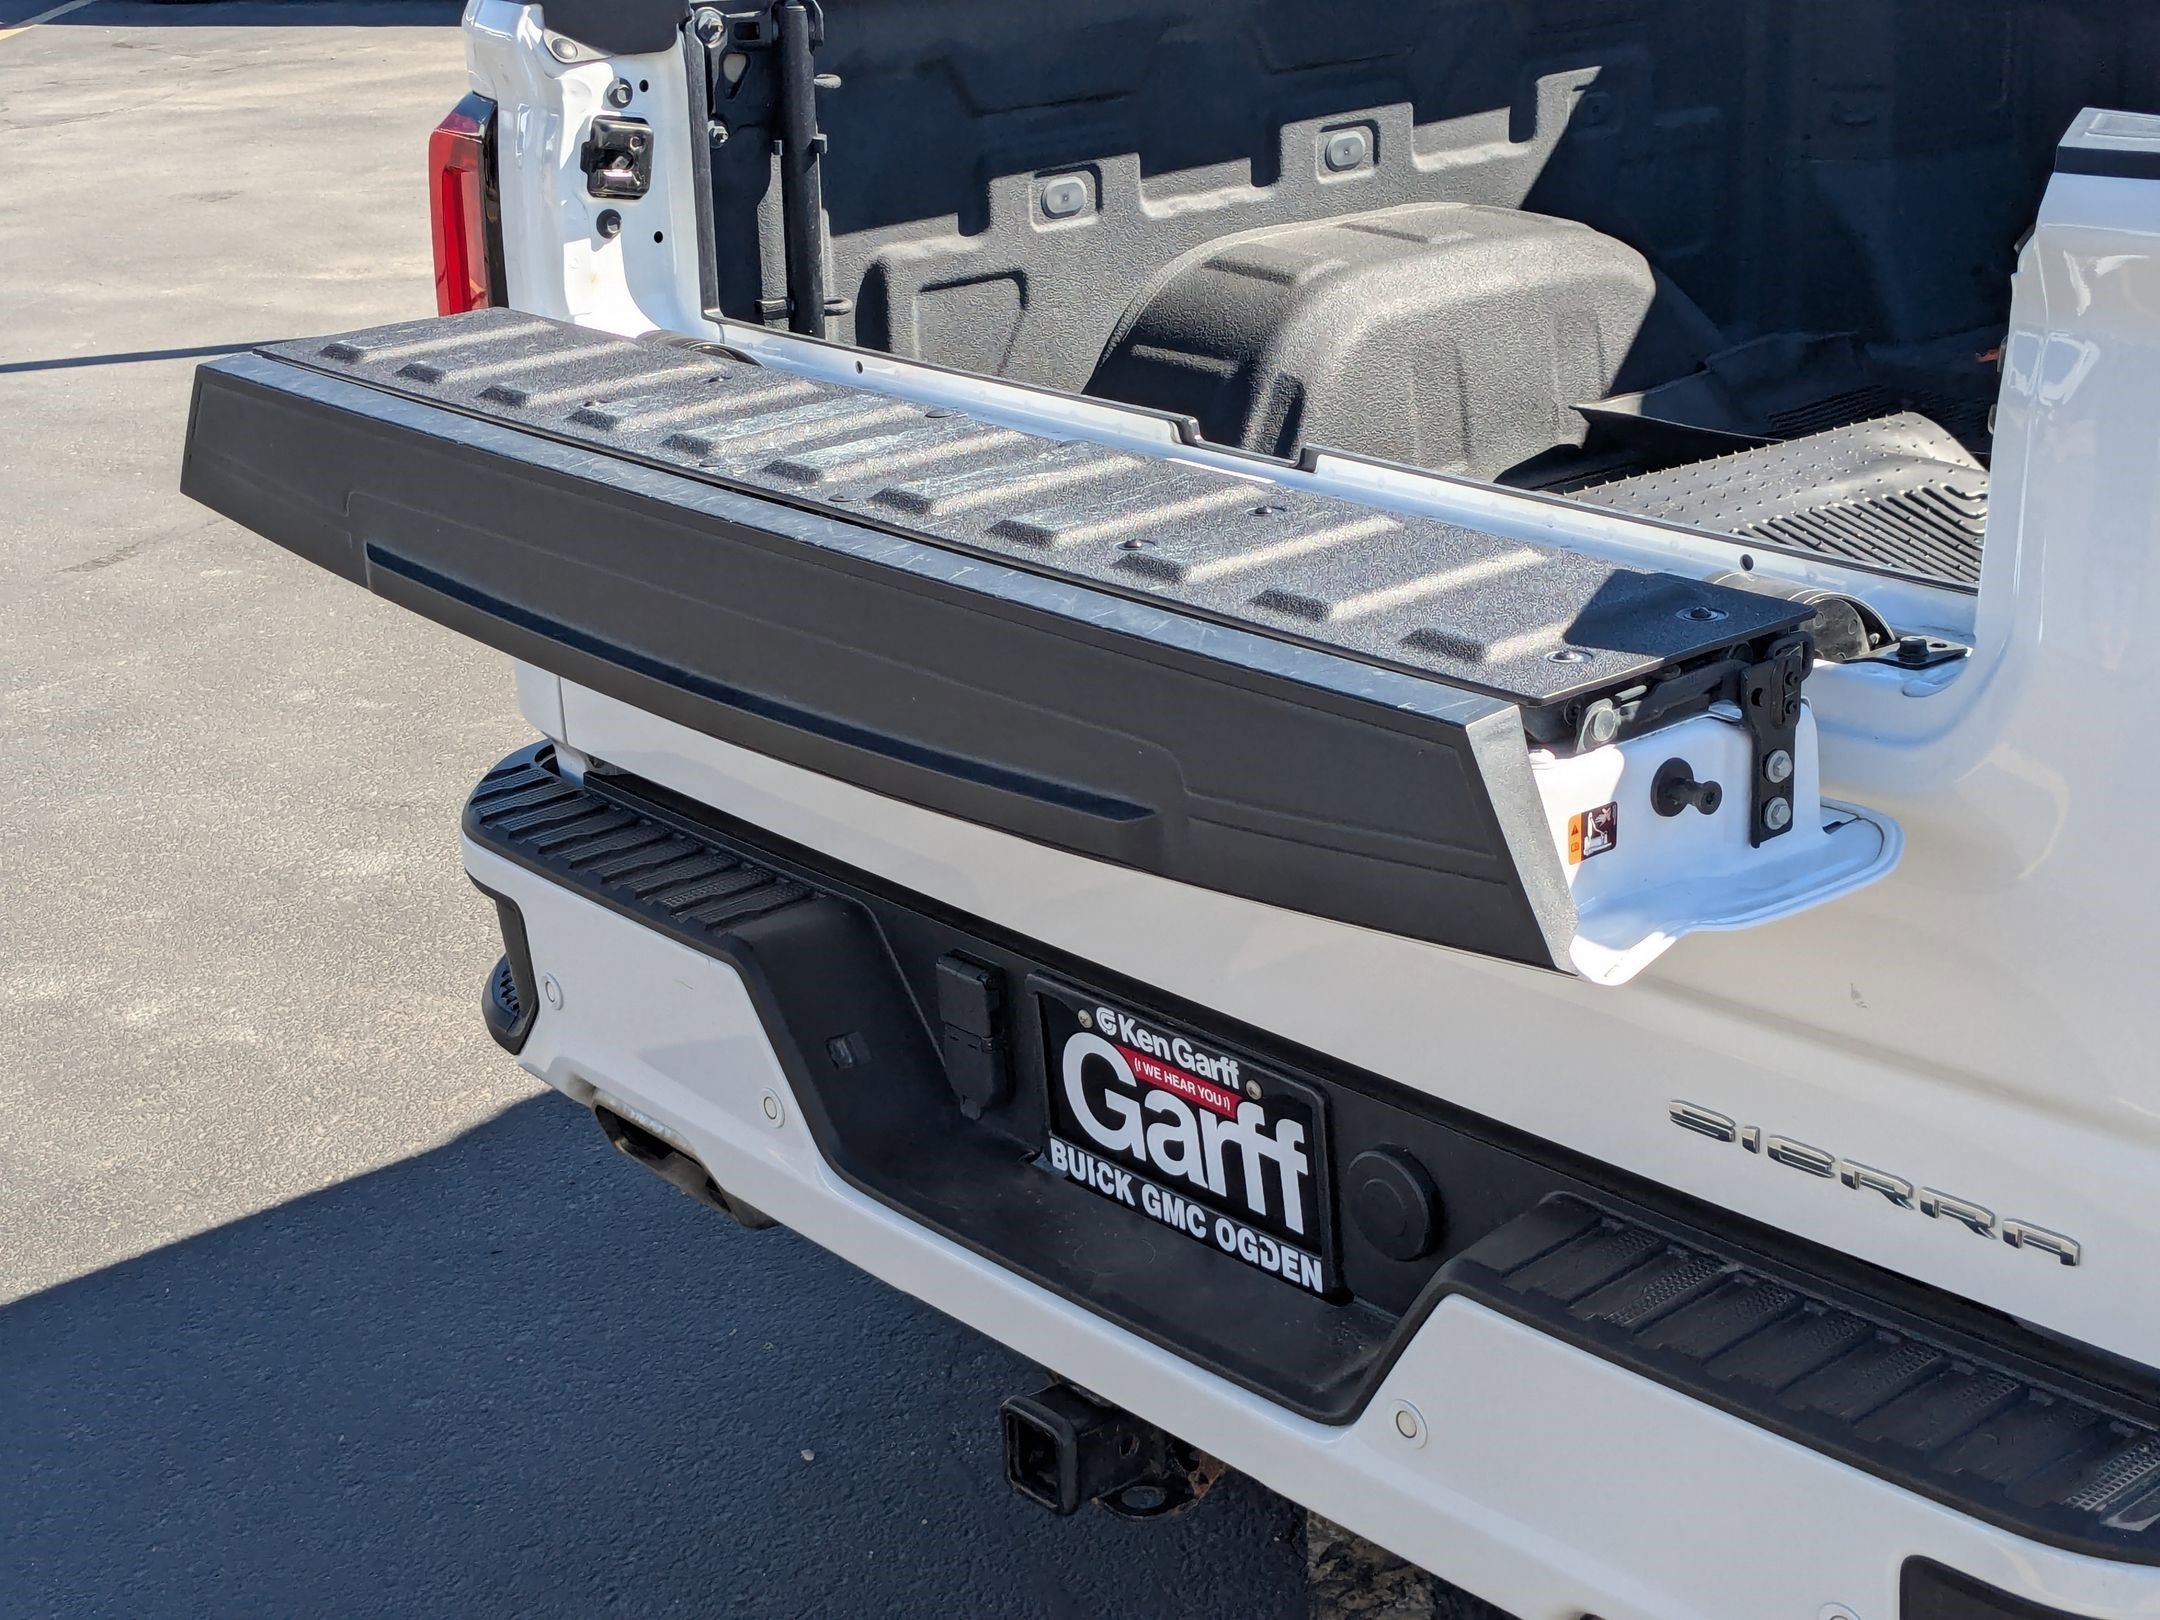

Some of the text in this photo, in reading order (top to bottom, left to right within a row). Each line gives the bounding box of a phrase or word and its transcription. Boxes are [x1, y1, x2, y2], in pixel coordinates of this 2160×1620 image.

[1118, 1013, 1171, 1061] Ken
[1173, 1038, 1240, 1089] Garff
[1144, 1059, 1222, 1108] WE HEAR YOU
[1063, 1032, 1308, 1234] Garff
[1668, 1100, 2080, 1266] SIERRA
[1050, 1138, 1323, 1293] BUICK GMC OGDEN
